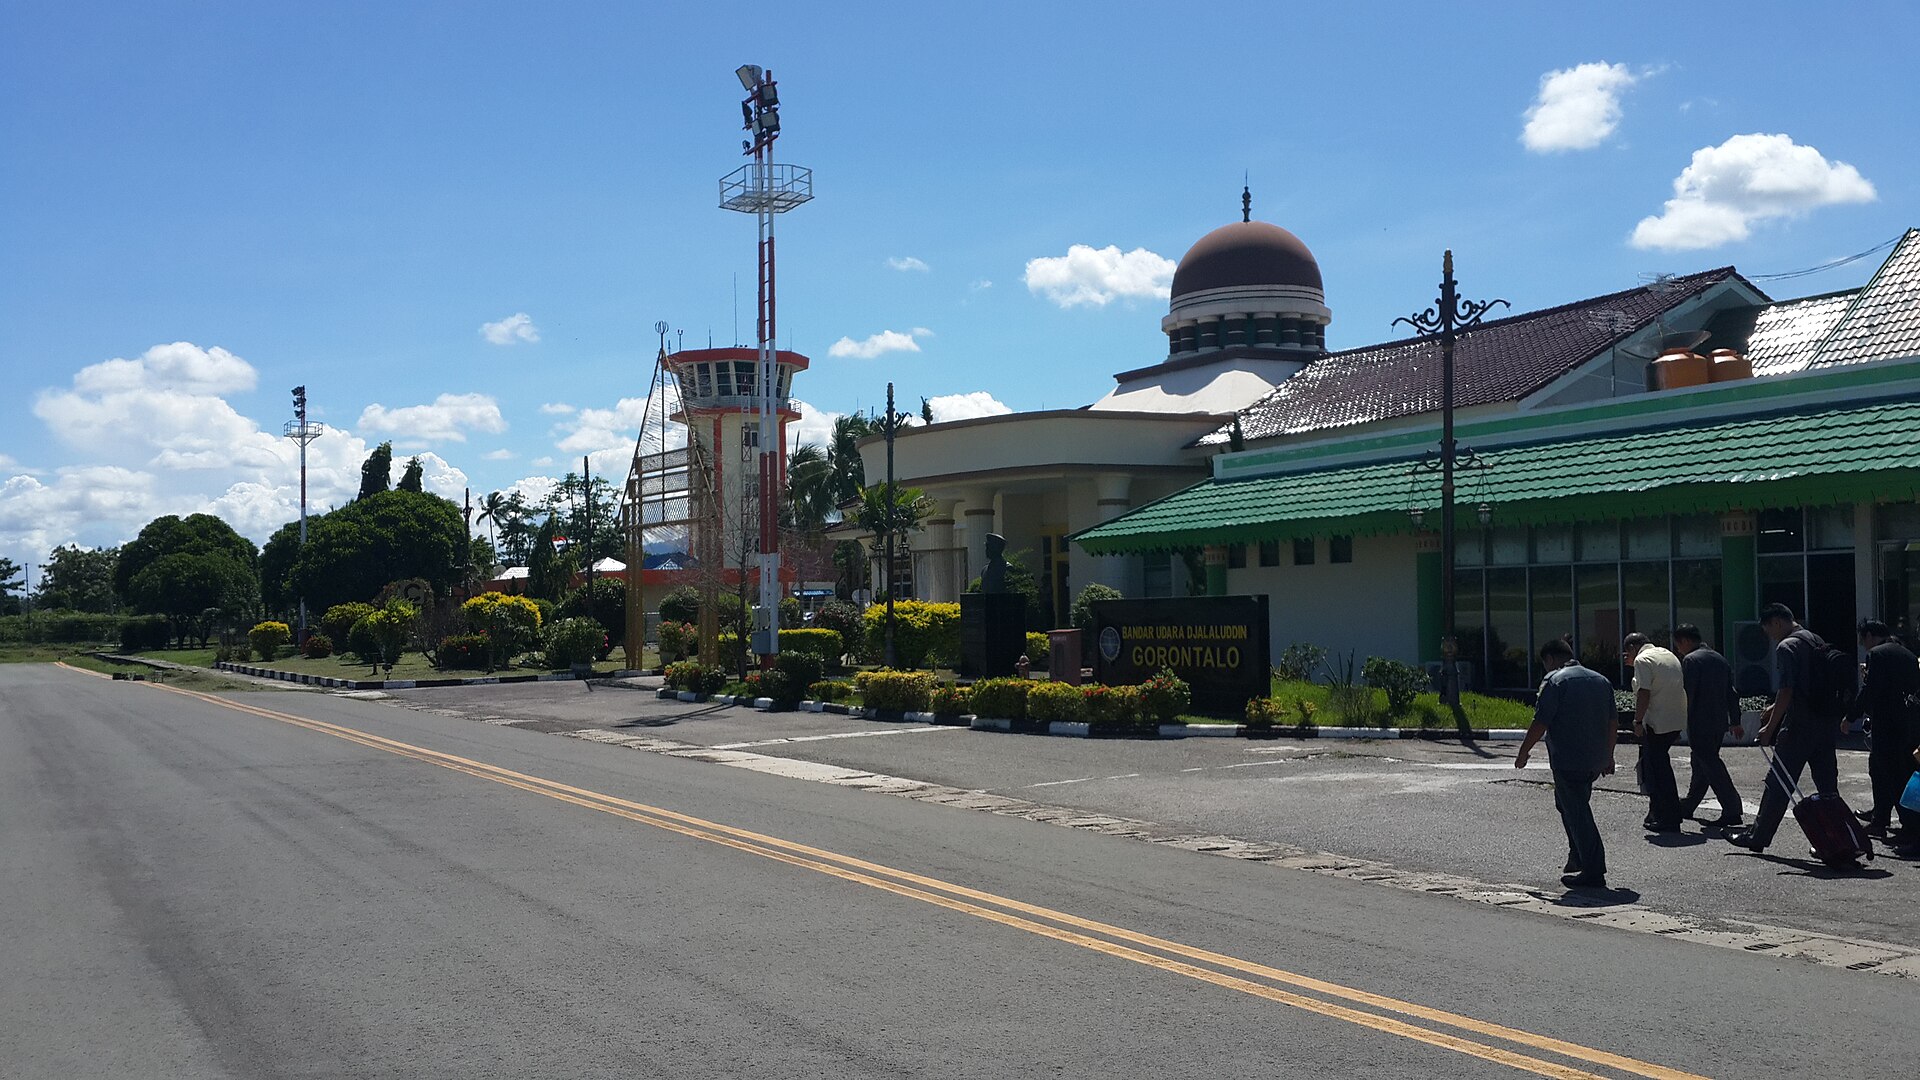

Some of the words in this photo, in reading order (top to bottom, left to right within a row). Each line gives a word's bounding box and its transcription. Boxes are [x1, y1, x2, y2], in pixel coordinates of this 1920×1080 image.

[1122, 626, 1154, 639] BANDAR
[1156, 626, 1184, 639] UDARA
[1187, 625, 1247, 639] DJALALUDDIN
[1132, 646, 1240, 668] GORONTALO
